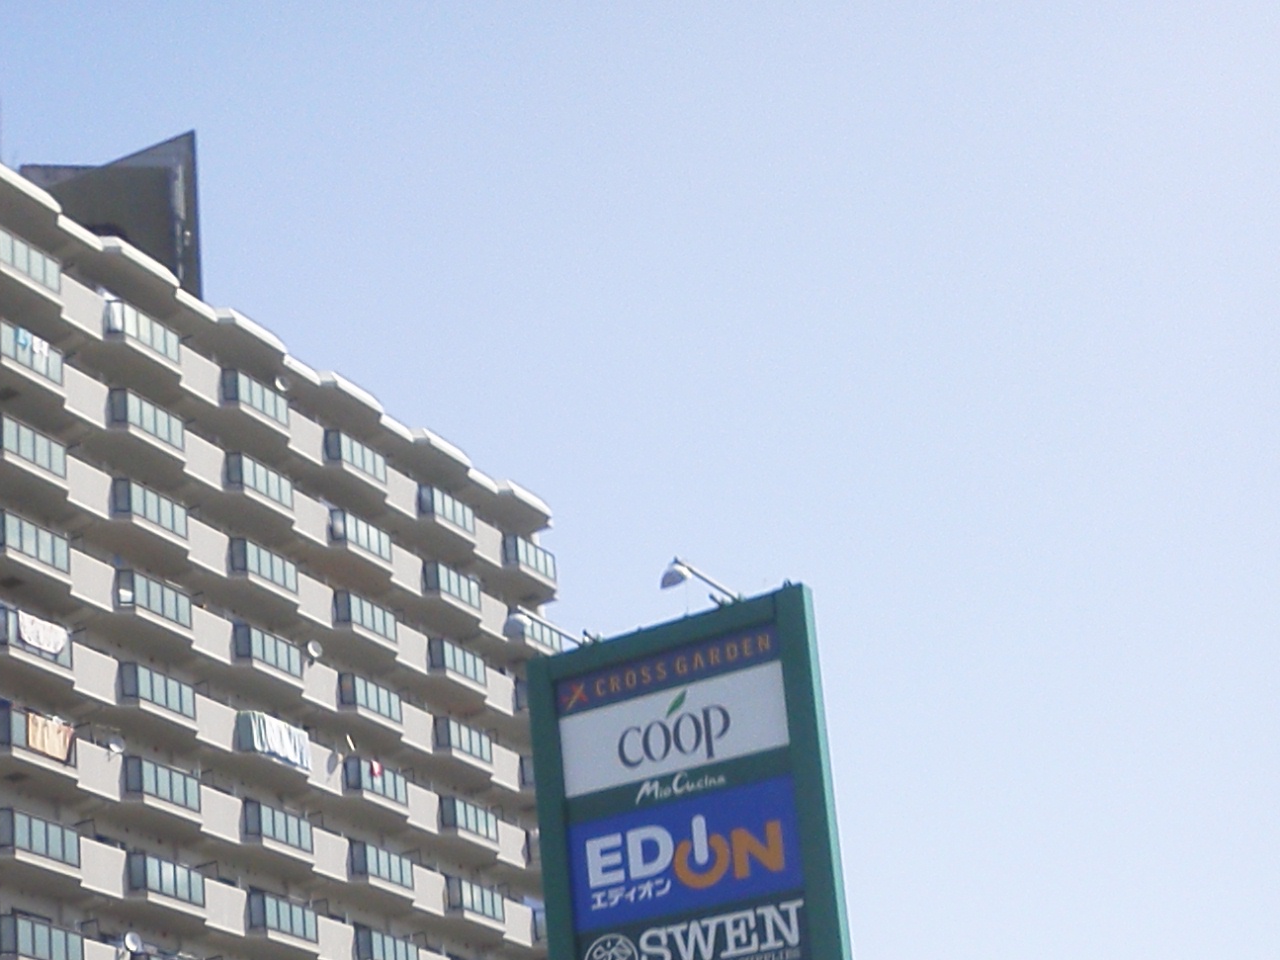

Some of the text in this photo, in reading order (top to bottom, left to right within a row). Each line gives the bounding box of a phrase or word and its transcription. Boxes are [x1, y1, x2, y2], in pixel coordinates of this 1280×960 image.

[595, 634, 771, 697] CROSS GARDEN
[619, 704, 731, 769] COOP
[586, 814, 785, 890] EDION
[591, 878, 671, 910] エディオン
